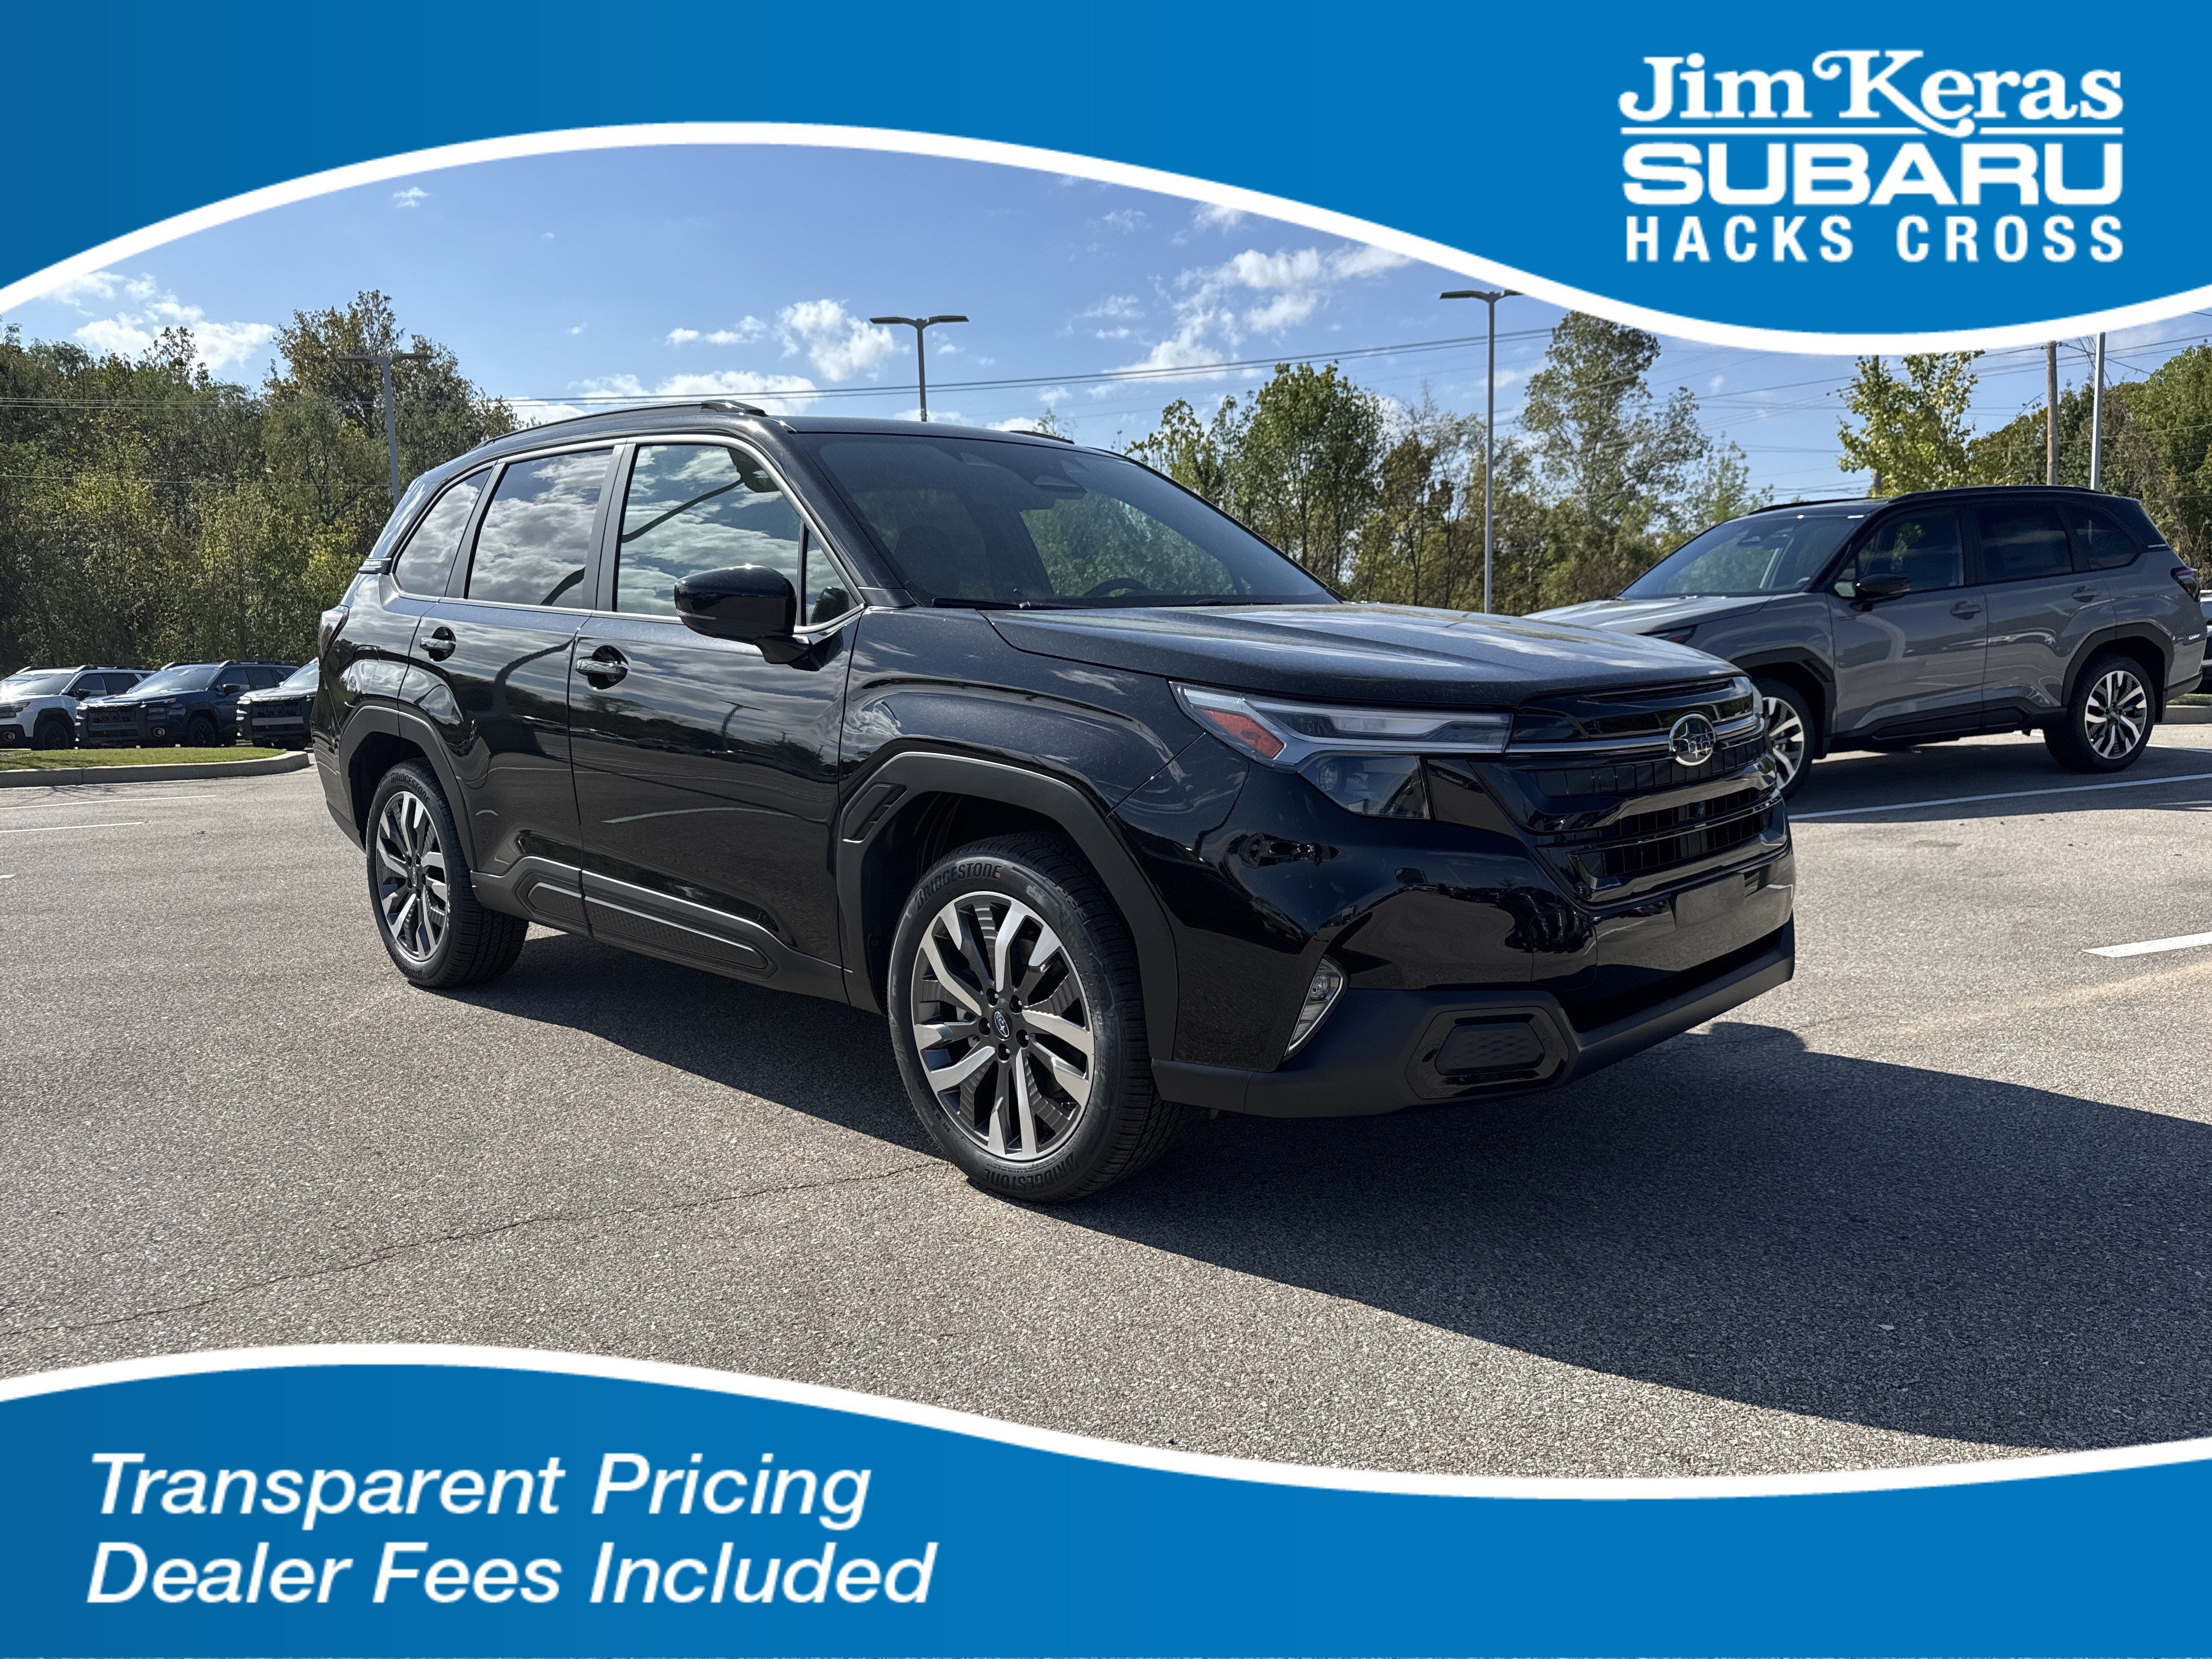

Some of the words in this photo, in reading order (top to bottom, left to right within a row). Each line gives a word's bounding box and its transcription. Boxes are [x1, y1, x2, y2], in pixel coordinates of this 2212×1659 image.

[390, 772, 430, 805] BRIDGESTONE
[915, 862, 1002, 912] BRIDGESTONE
[983, 1151, 1080, 1191] BRIDGESTONE
